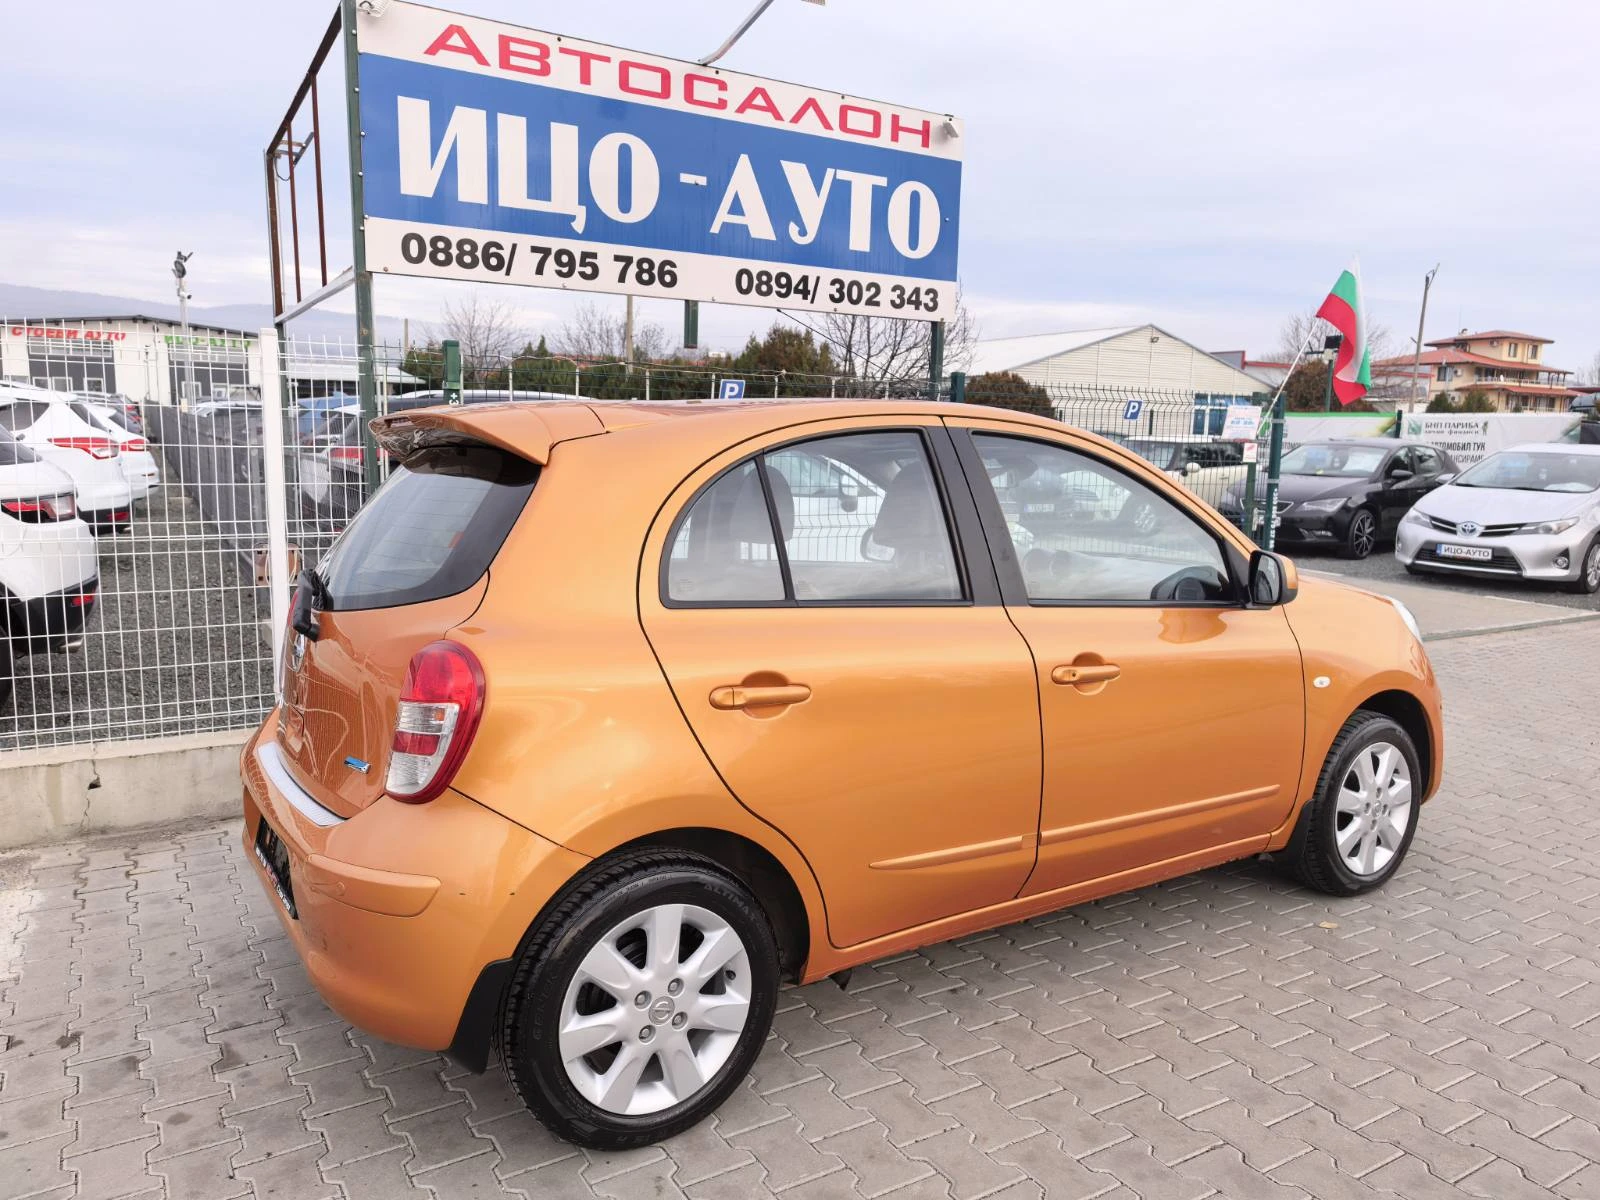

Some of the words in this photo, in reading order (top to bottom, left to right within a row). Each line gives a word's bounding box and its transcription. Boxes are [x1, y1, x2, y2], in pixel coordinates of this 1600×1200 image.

[424, 23, 931, 149] АВТОСАЛОН
[397, 95, 660, 234] ИЦО
[400, 232, 517, 277] 0886/
[530, 245, 600, 281] 795
[613, 254, 678, 288] 786
[735, 267, 820, 305] 0894/
[828, 277, 881, 307] 302
[890, 284, 939, 313] 343
[724, 383, 739, 399] P
[1127, 402, 1139, 418] P
[1473, 442, 1486, 451] ТУК
[1444, 546, 1490, 557] ИЦО-АУТО
